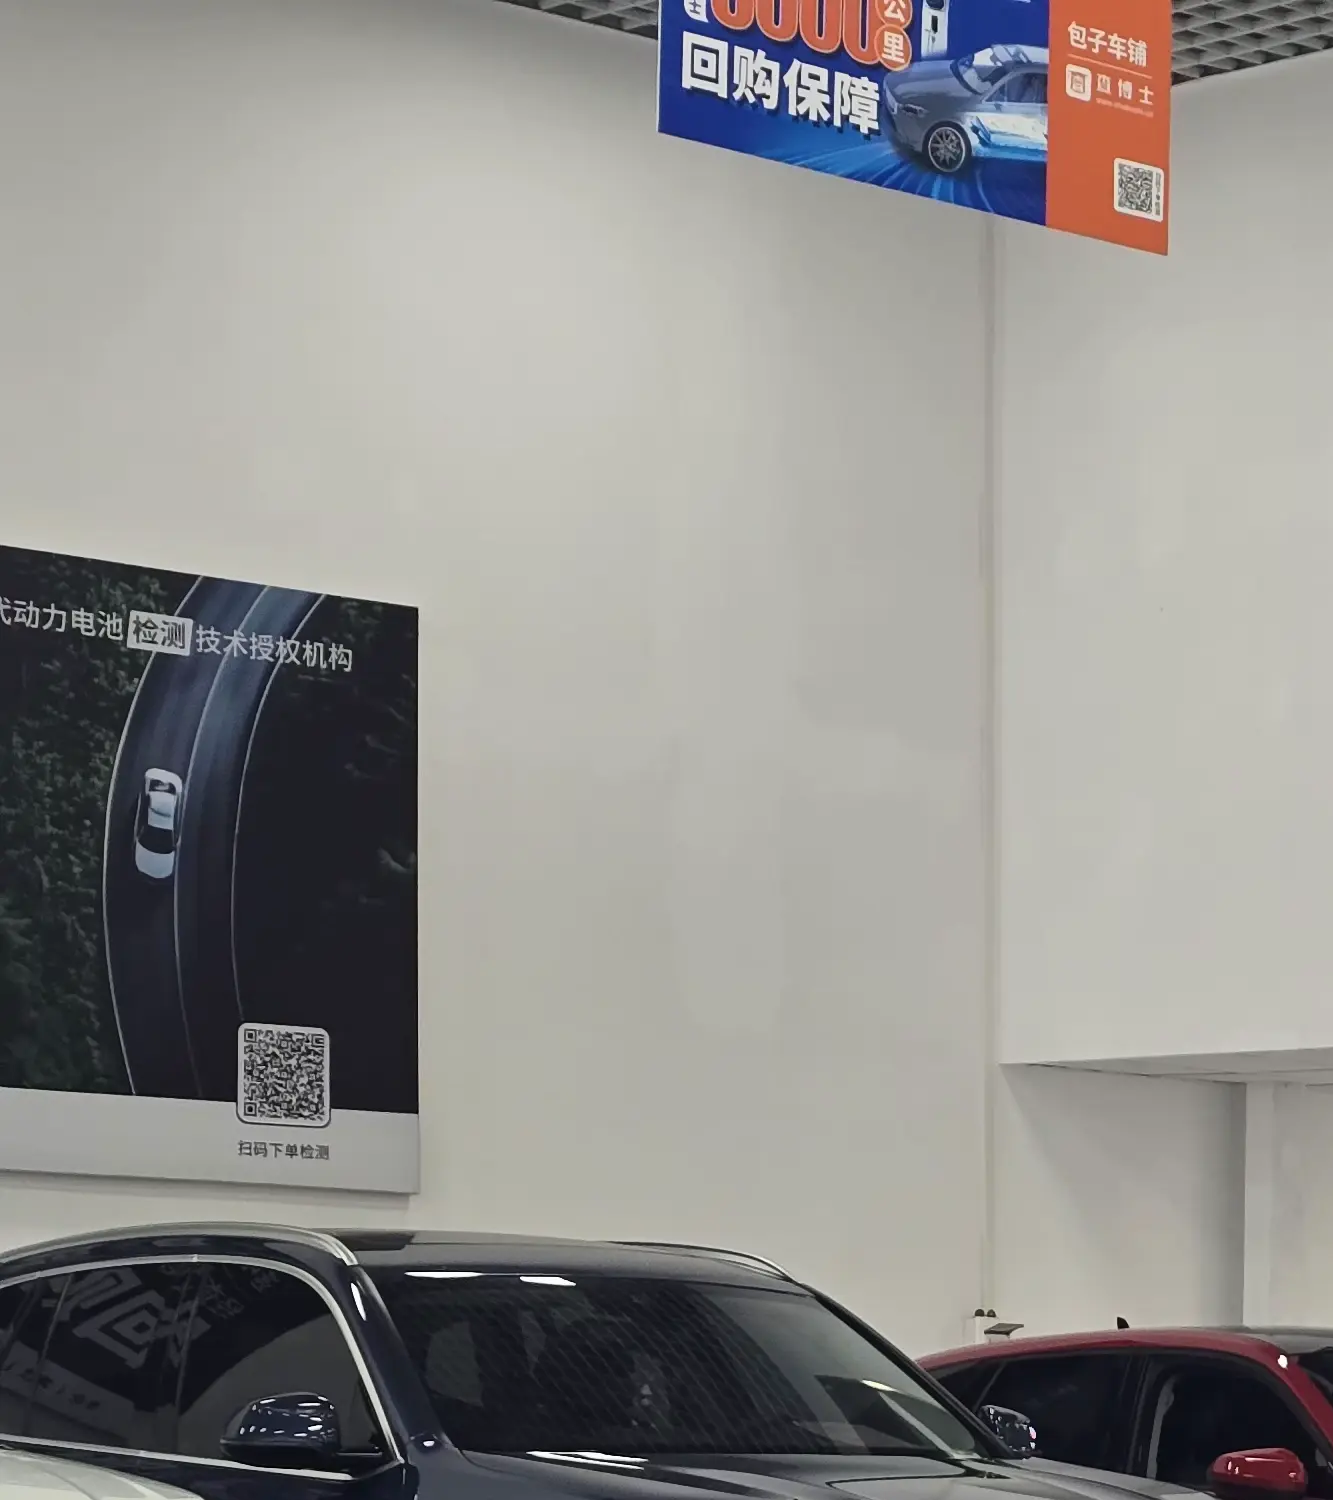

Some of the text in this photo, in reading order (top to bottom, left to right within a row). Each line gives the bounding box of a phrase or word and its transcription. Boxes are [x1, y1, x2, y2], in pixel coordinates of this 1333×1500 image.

[1068, 21, 1147, 67] 包子车铺
[682, 31, 880, 135] 回购保障
[238, 1140, 330, 1161] 扫码下单检测
